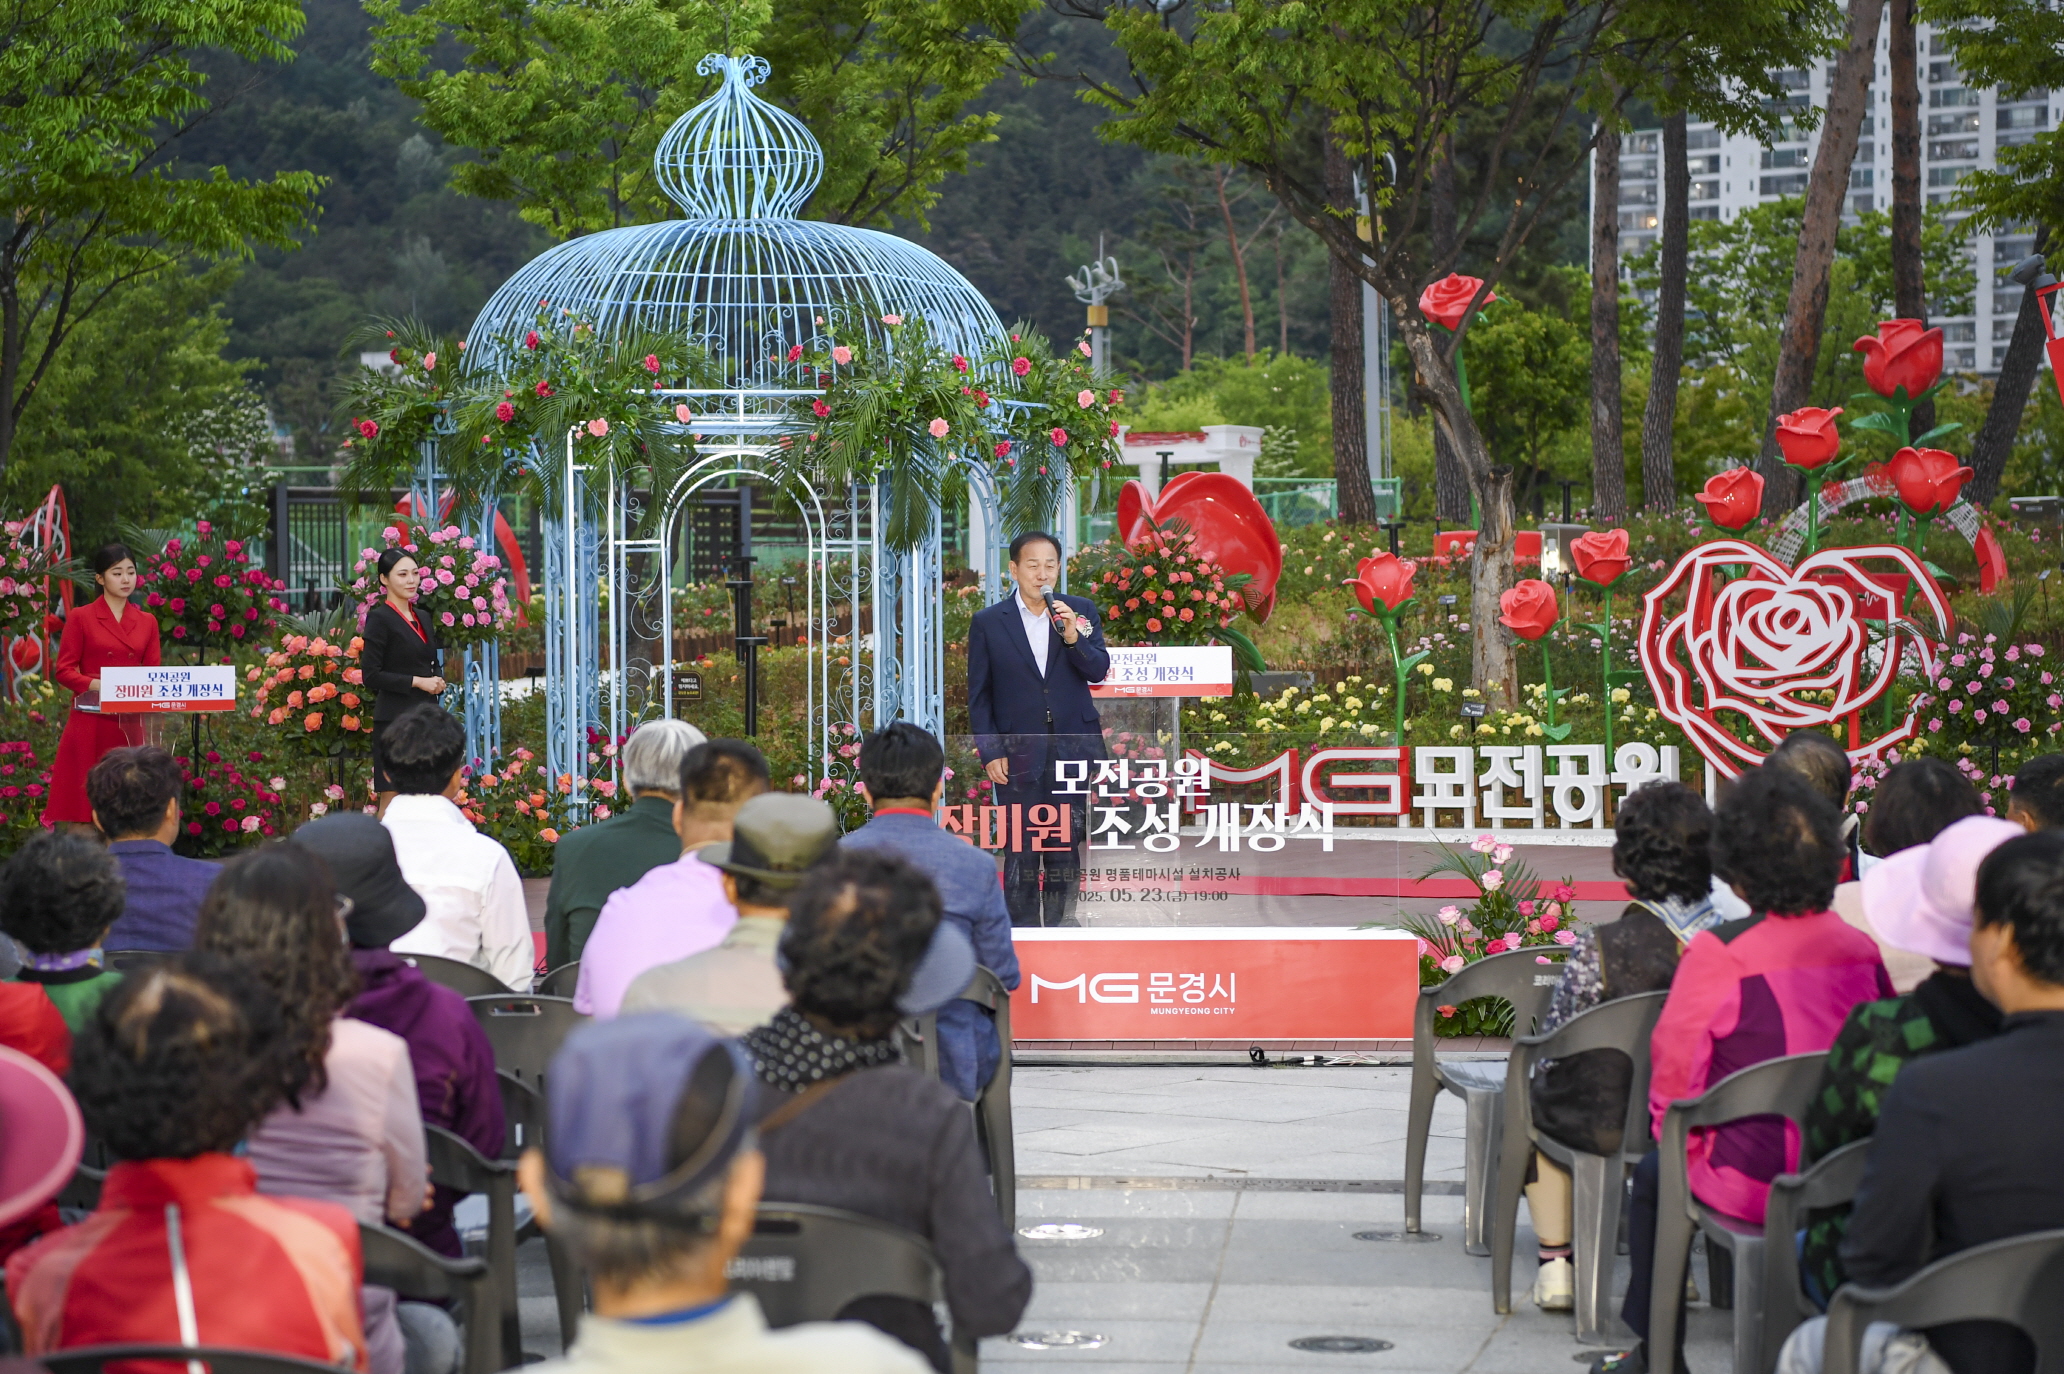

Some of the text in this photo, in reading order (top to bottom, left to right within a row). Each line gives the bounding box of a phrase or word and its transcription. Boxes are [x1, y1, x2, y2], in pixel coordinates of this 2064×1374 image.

[1110, 653, 1157, 665] 모전공원
[147, 671, 191, 683] 모전공원
[1121, 666, 1148, 682] 조성
[1153, 666, 1194, 682] 개장식
[114, 683, 223, 698] 장미원 조성 개장식
[1114, 686, 1135, 694] MG
[1051, 758, 1211, 797] 모전공원
[1183, 741, 1679, 823] MG 모전공원
[938, 801, 1334, 853] 장미원 조성 개장식
[1105, 867, 1184, 882] 명품테마시설
[1188, 867, 1241, 882] 설치공사
[1109, 887, 1136, 903] 05.
[1193, 889, 1228, 902] 19:00
[1031, 972, 1236, 1003] MG 문경시
[1150, 1007, 1236, 1015] MUNGYEONG CITY
